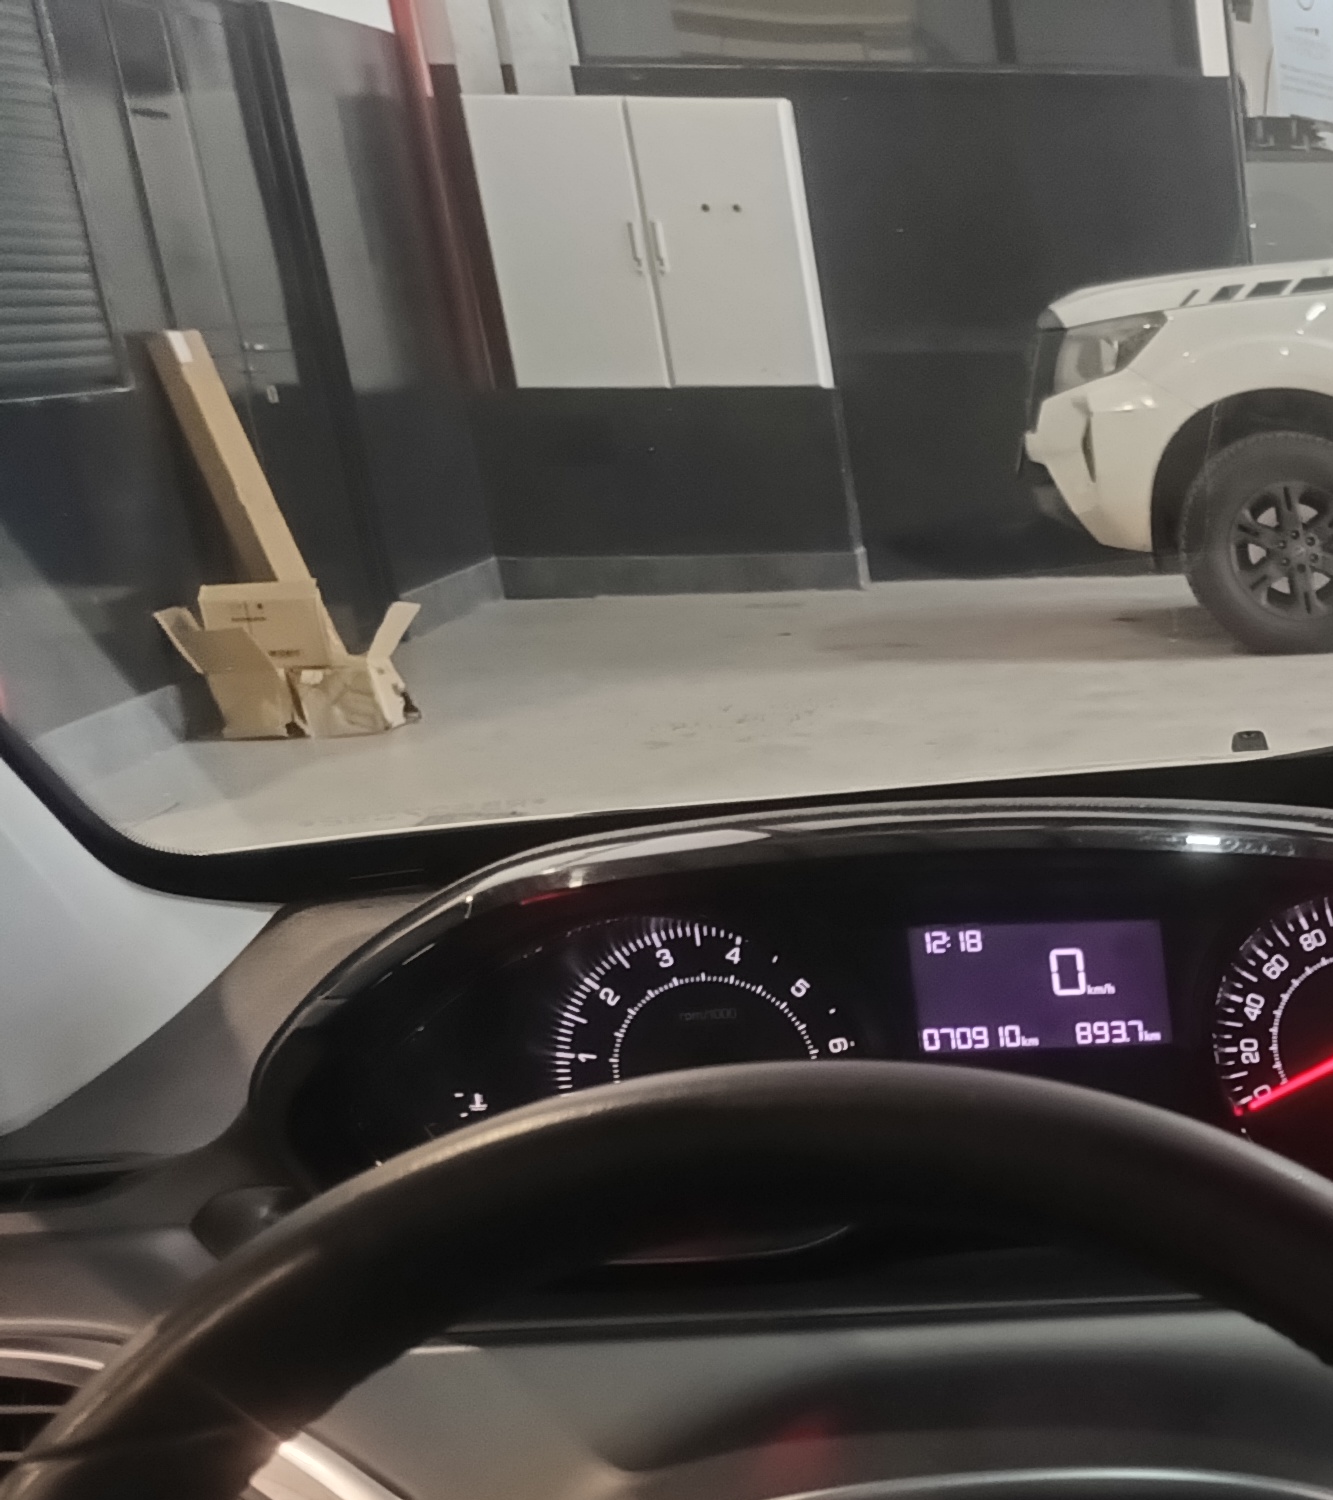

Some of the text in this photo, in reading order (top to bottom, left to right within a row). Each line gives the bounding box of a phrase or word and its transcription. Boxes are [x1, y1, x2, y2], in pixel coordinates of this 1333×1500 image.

[924, 929, 983, 954] 12:18
[1298, 928, 1327, 952] 80
[655, 948, 675, 968] 3
[724, 946, 742, 965] 4
[1262, 953, 1290, 980] 60
[1049, 948, 1087, 996] 0
[599, 987, 621, 1007] 2
[790, 978, 811, 998] 5
[1243, 992, 1266, 1022] 40
[577, 1052, 598, 1063] 1
[1239, 1037, 1261, 1065] 20
